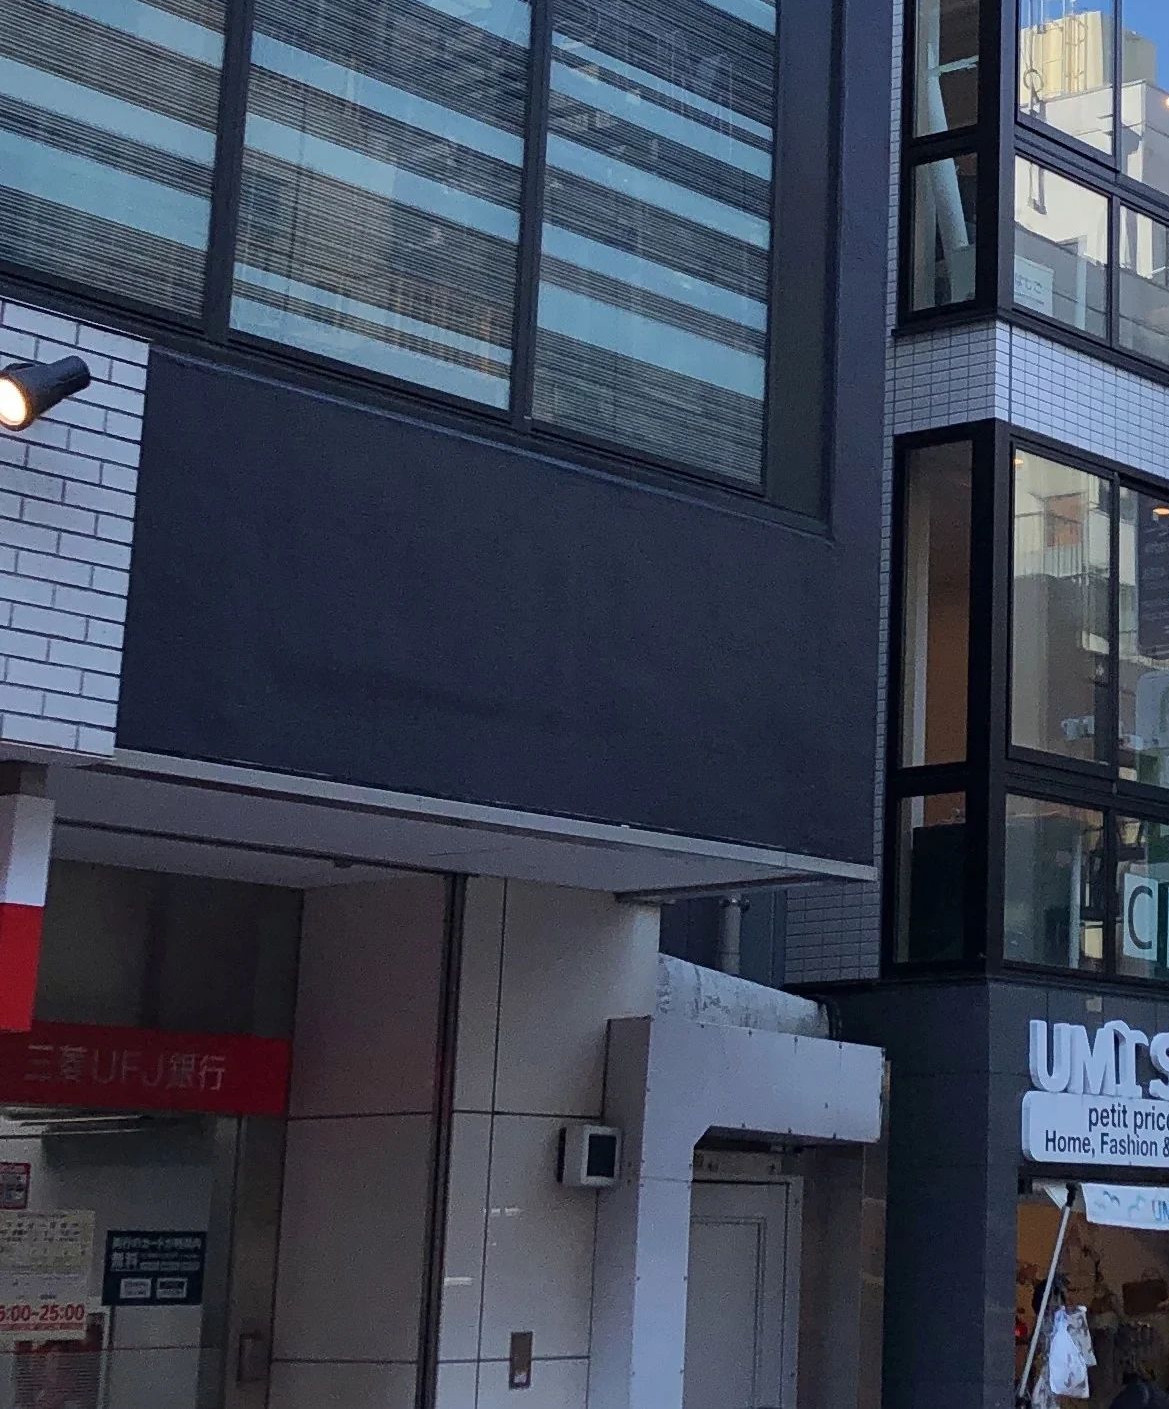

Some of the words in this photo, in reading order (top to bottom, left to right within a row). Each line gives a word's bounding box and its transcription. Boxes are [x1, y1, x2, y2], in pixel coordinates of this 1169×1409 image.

[23, 1044, 226, 1091] 三菱UFJ銀行
[1088, 1102, 1129, 1129] petit
[1045, 1130, 1096, 1158] Home,
[1100, 1132, 1158, 1158] Fashion
